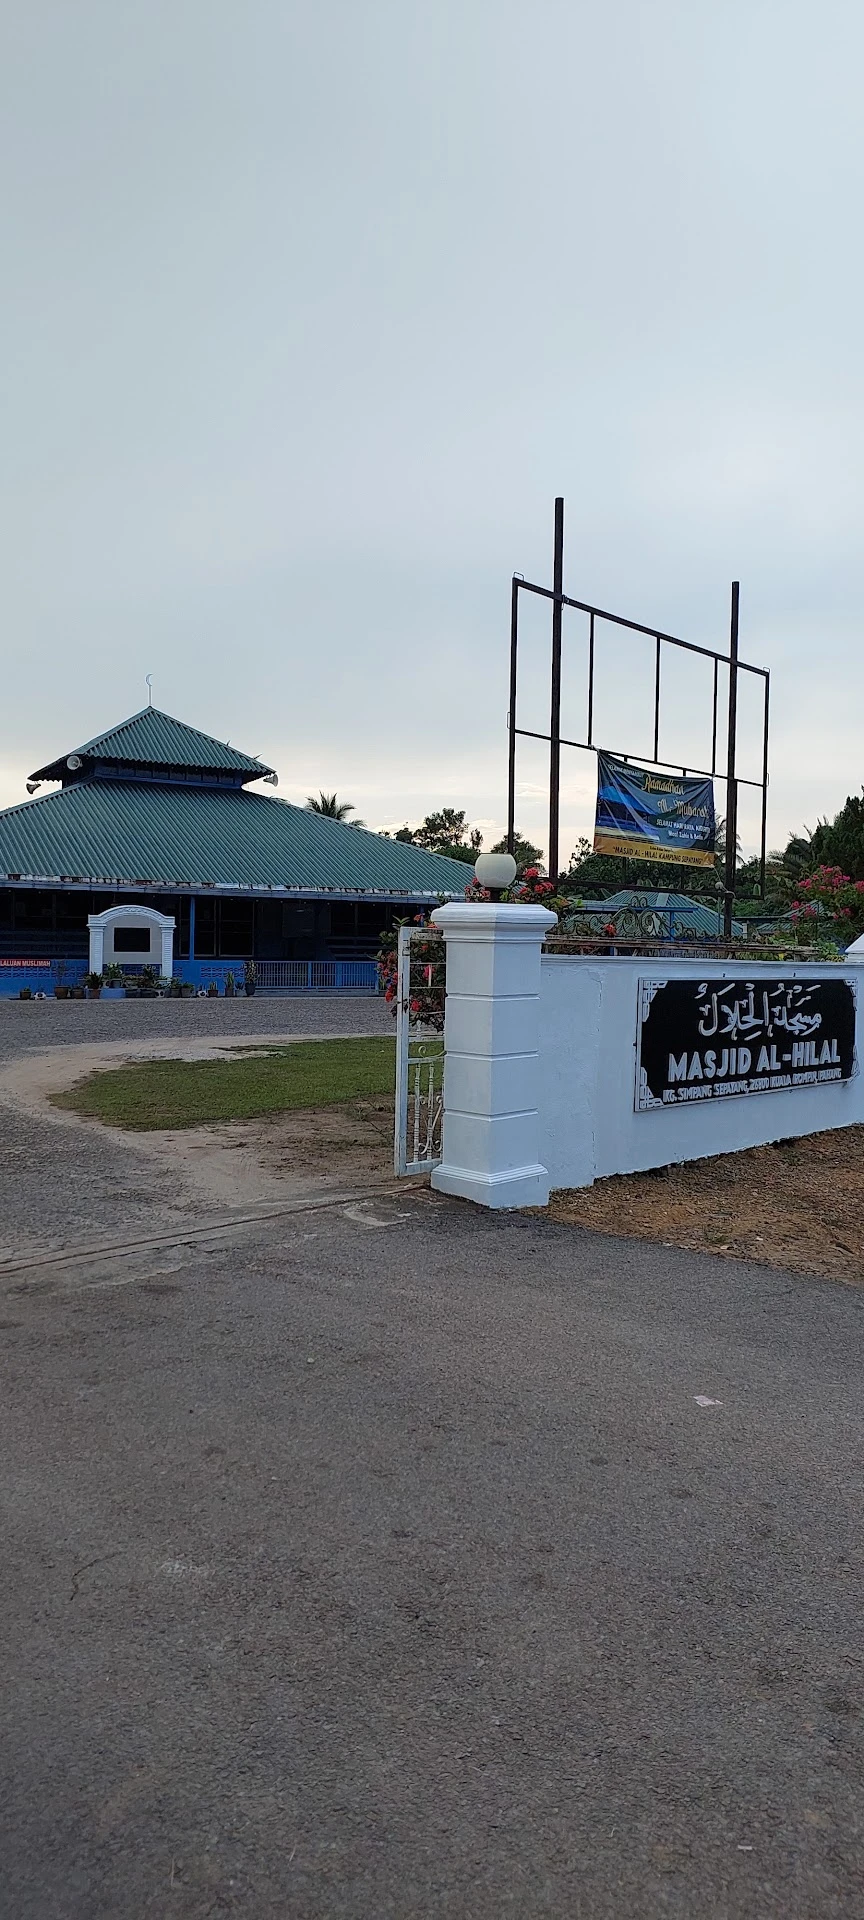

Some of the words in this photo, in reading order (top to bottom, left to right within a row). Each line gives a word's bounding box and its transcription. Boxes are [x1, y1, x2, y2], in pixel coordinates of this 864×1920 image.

[641, 773, 685, 795] Ramadhan
[644, 851, 658, 859] HILAL
[658, 852, 681, 862] KAMPUNG
[668, 1047, 752, 1083] MASJID
[756, 1038, 841, 1073] AL-HILAL
[663, 1089, 677, 1103] KG.
[677, 1085, 712, 1100] SIMPANG
[713, 1080, 750, 1096] SEPAYANG,
[770, 1074, 792, 1088] KUALA
[818, 1068, 842, 1082] PAHANG
